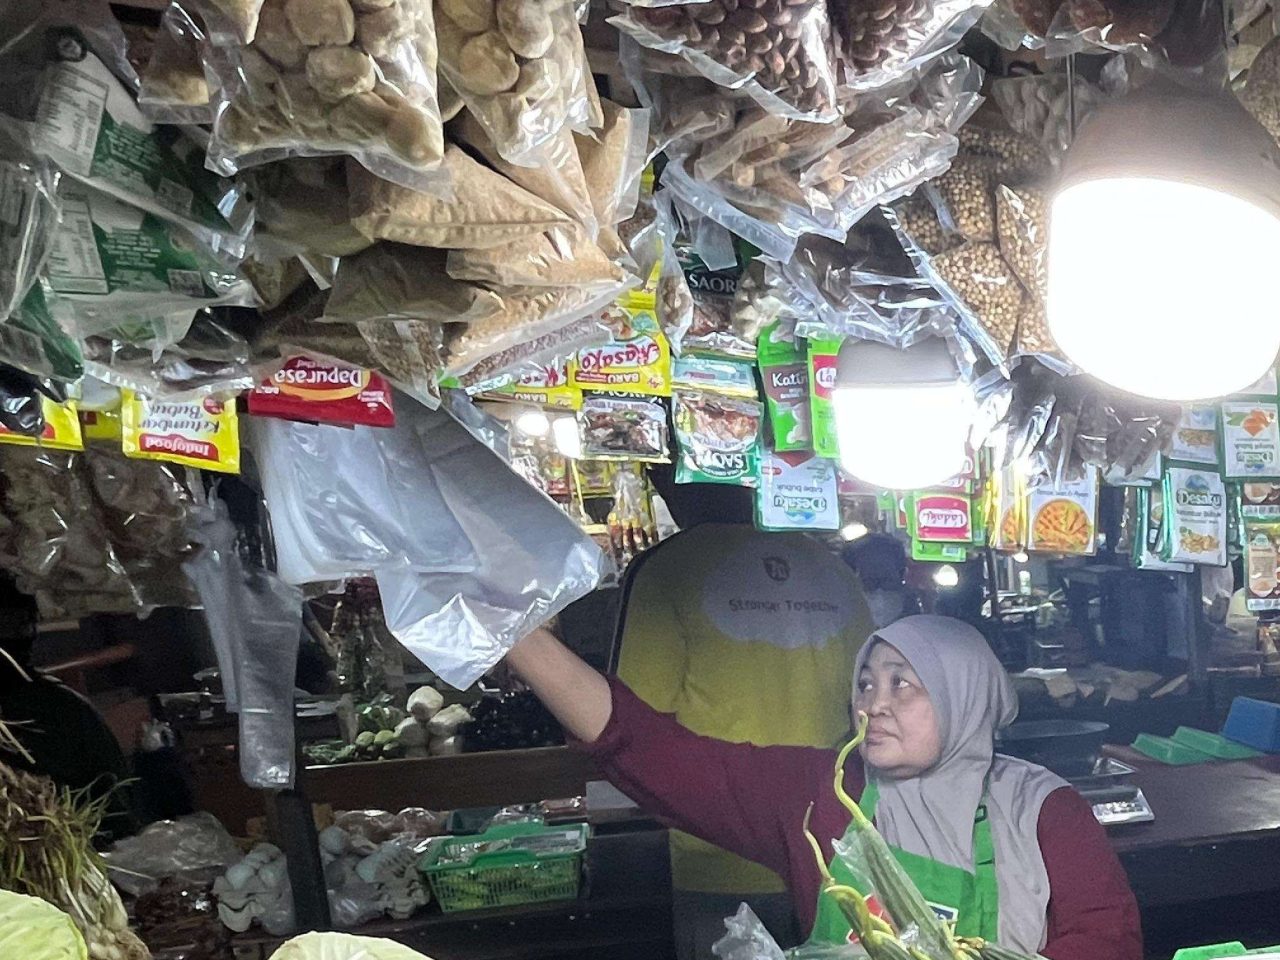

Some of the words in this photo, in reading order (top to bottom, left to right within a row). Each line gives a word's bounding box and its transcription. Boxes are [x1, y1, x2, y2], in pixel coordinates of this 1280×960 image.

[581, 344, 659, 373] Masako
[274, 366, 363, 388] Dapurasa
[607, 373, 639, 384] BARU
[138, 418, 220, 434] Ketumbar
[144, 435, 210, 457] Indofood
[774, 493, 826, 513] Desaku
[1176, 488, 1222, 509] Desaku
[785, 599, 839, 613] Together
